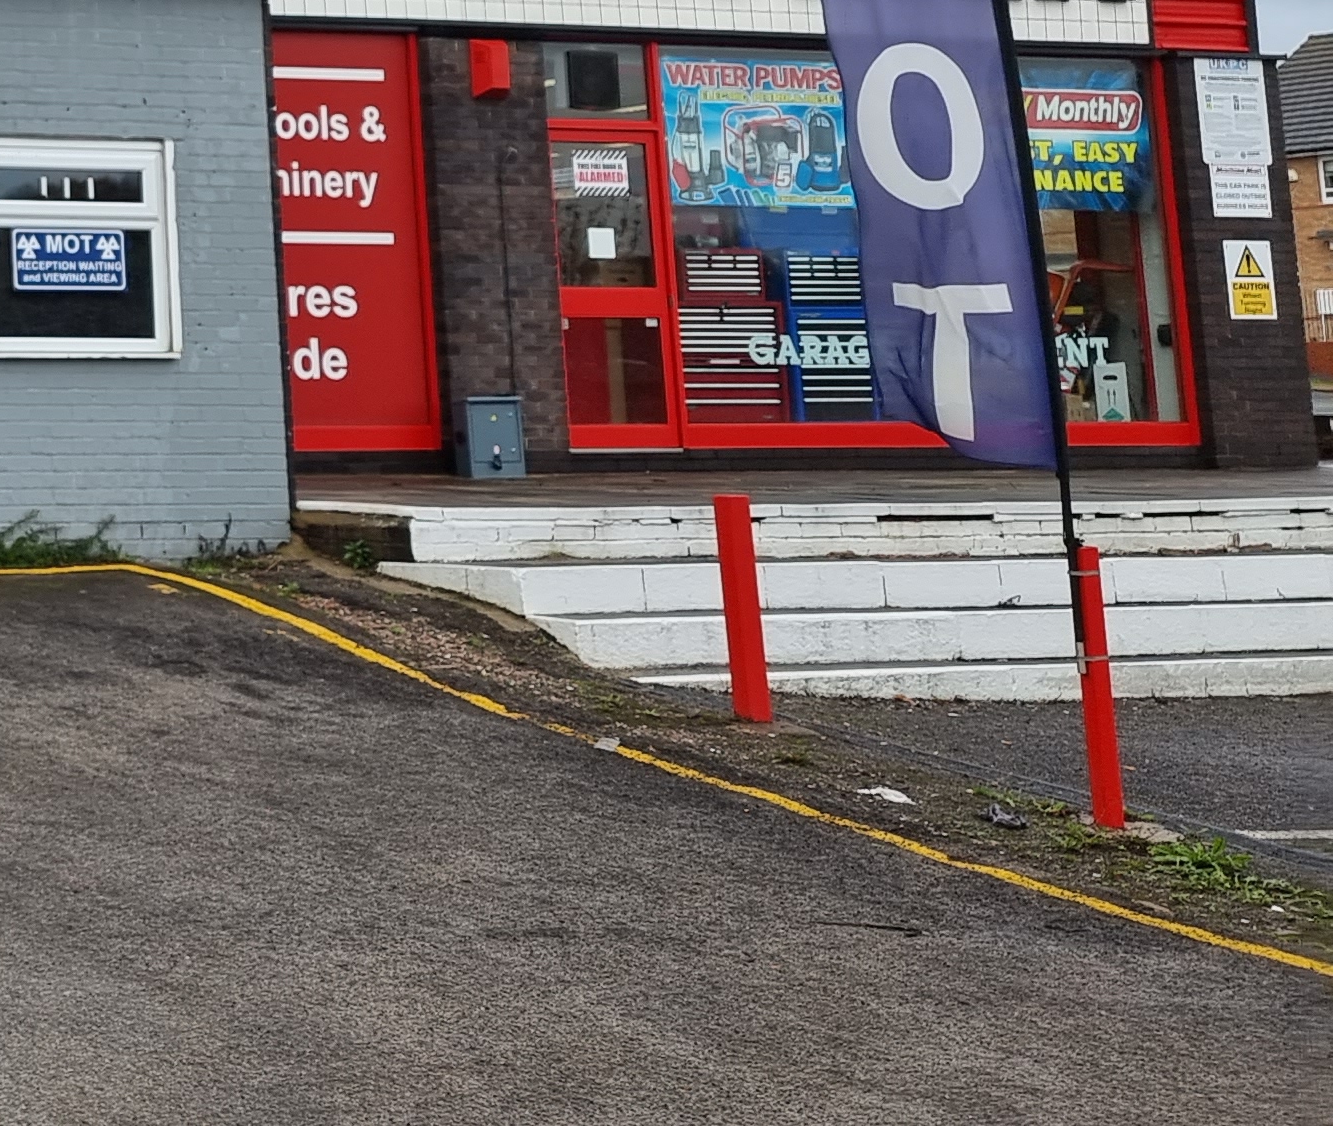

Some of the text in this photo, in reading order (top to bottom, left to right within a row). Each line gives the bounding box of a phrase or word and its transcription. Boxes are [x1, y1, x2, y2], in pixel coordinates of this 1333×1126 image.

[664, 61, 843, 92] WATER PUMPS
[1036, 94, 1136, 129] Monthly
[274, 105, 387, 143] ools &
[1073, 140, 1138, 164] EASY
[578, 171, 624, 183] ALARMED
[1034, 169, 1125, 193] NANCE
[45, 235, 93, 254] MOT
[17, 260, 122, 271] RECEPTION WAITING
[23, 273, 118, 283] and VIEWING AREA
[1232, 282, 1270, 291] CAUTION
[290, 337, 349, 381] de
[748, 334, 871, 365] GARAG
